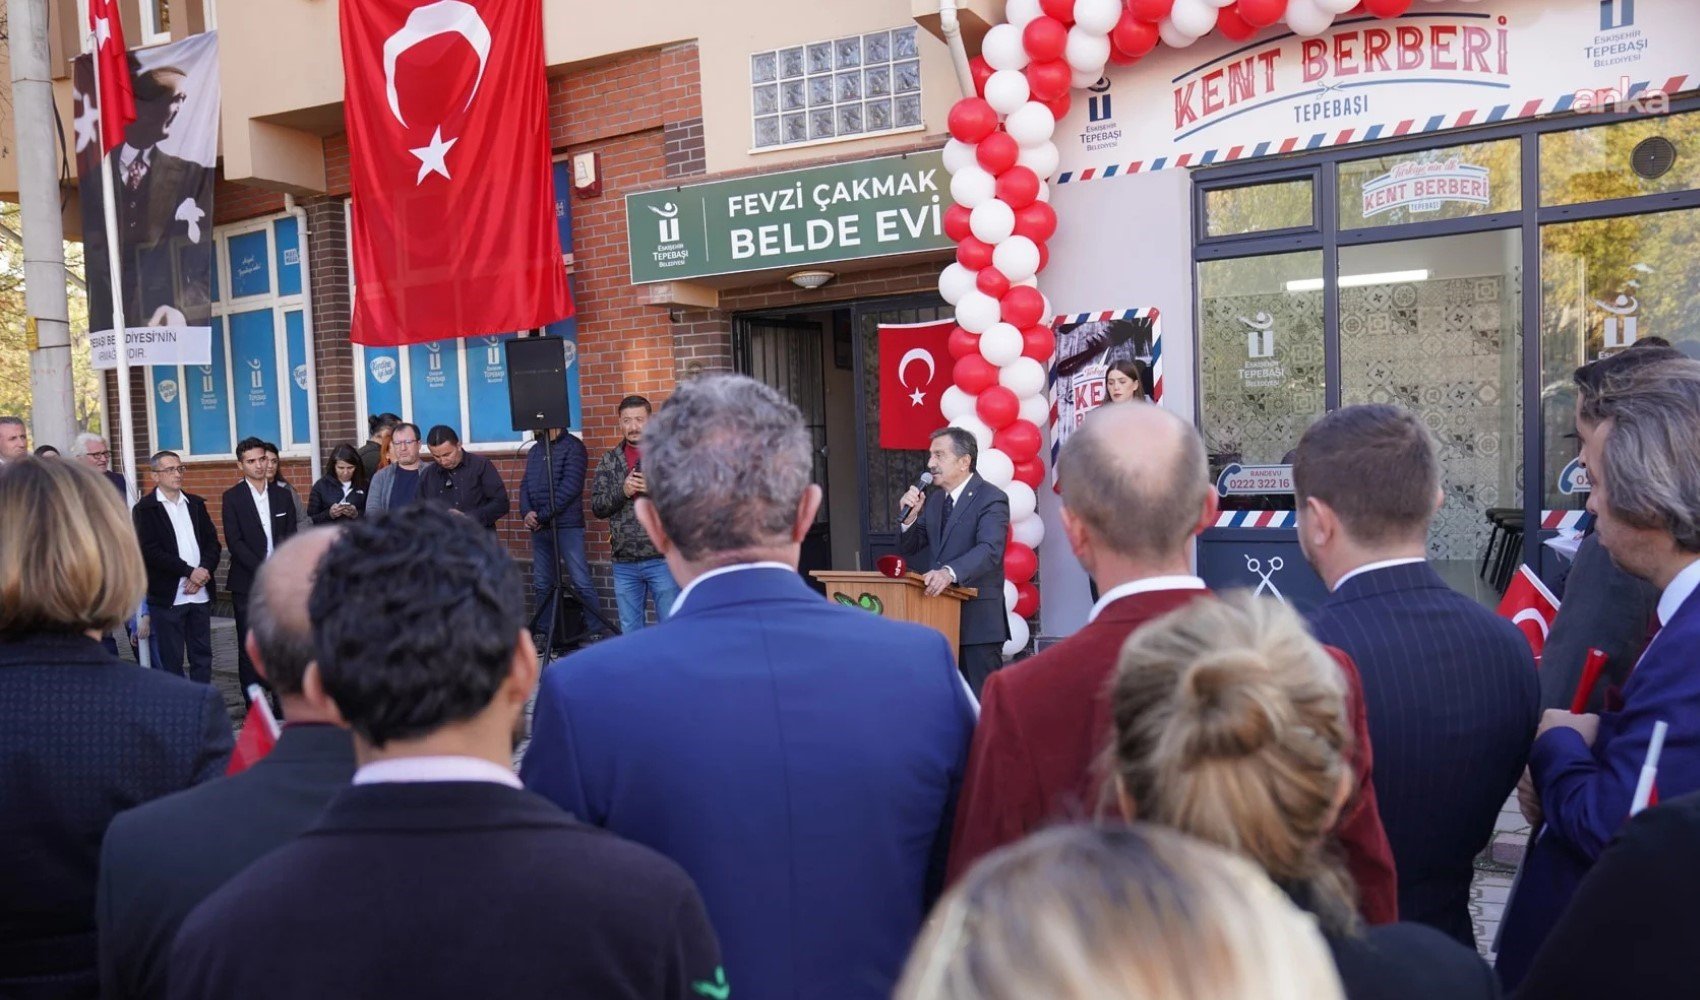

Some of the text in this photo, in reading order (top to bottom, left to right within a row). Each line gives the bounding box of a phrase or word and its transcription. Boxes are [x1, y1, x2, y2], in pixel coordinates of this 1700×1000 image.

[1584, 38, 1648, 59] TEPEBAŞI
[1173, 15, 1509, 130] KENT BERBERİ
[1294, 94, 1368, 123] TEPEBAŞI
[1080, 130, 1122, 143] TEPEBAŞI
[728, 168, 938, 217] FEVZİ ÇAKMAK
[1364, 177, 1487, 211] KENT BERBERİ
[730, 194, 941, 260] BELDE EVİ
[652, 250, 689, 261] TEPEBAŞI
[1239, 367, 1284, 379] TEPEBAŞI
[1074, 381, 1104, 411] KE
[1230, 479, 1290, 488] 0222 322 16
